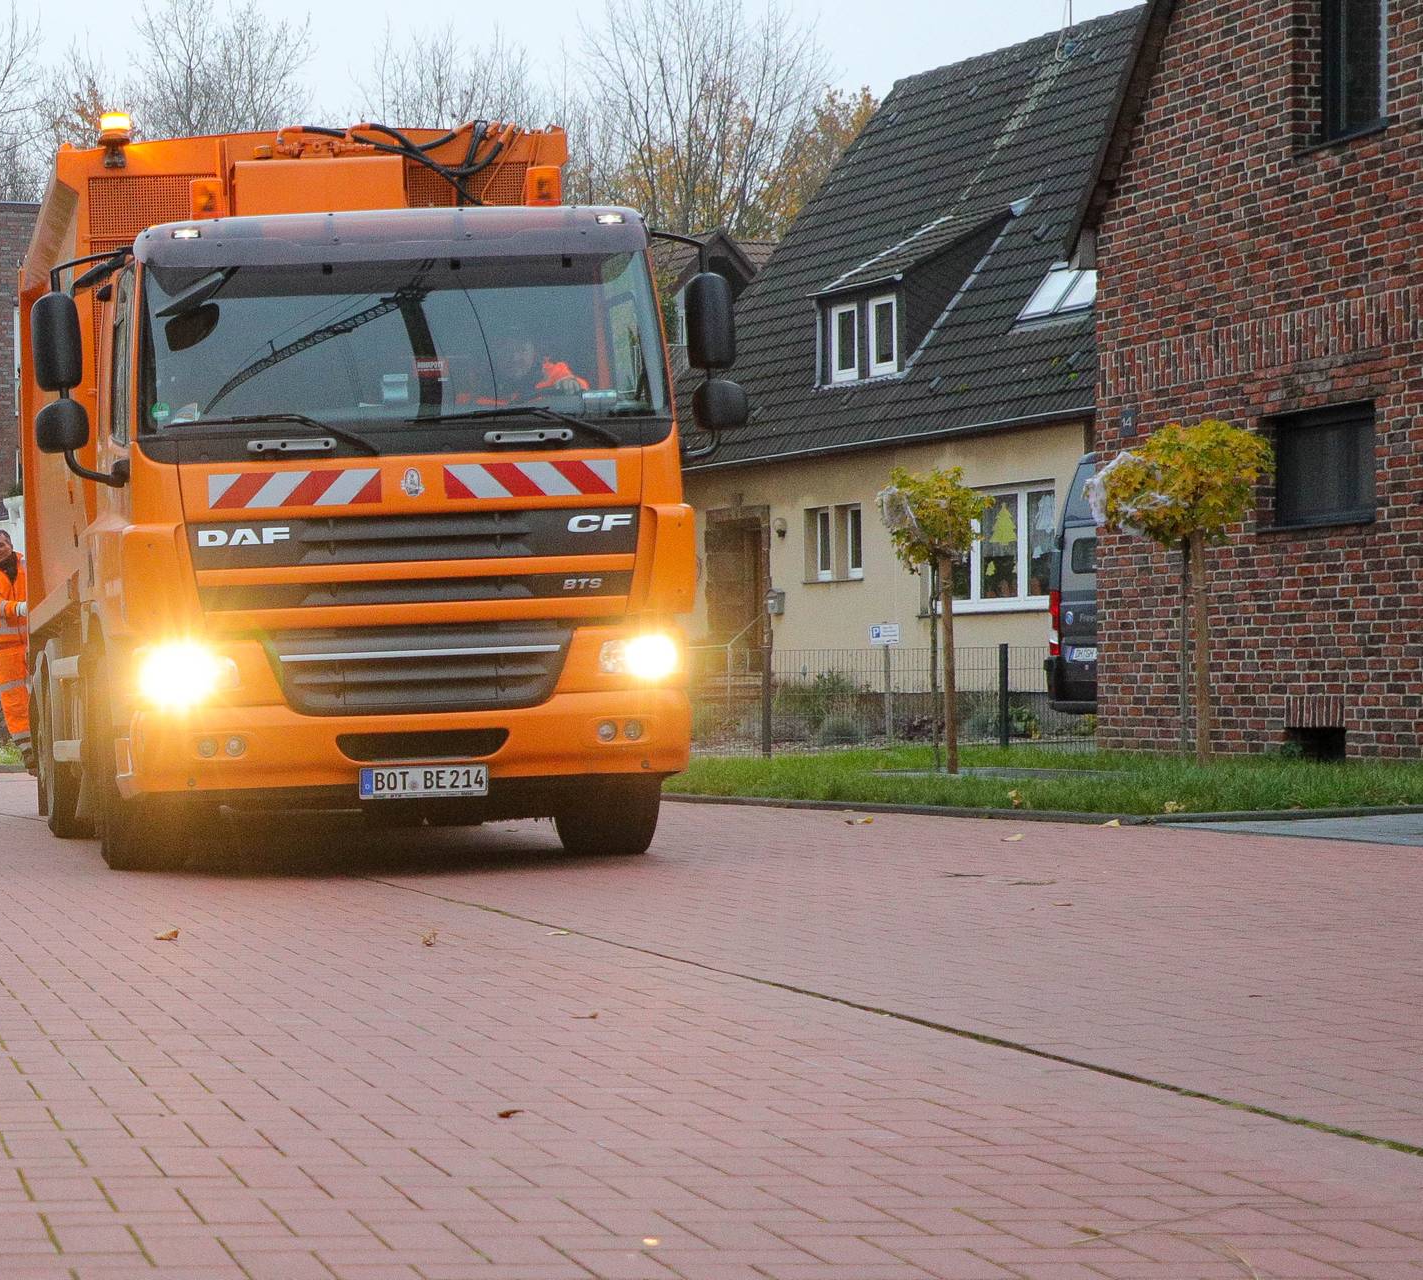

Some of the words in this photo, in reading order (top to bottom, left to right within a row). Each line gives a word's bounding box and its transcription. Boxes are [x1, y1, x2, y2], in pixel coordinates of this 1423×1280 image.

[1122, 416, 1132, 427] 14
[567, 514, 633, 533] CF
[198, 527, 289, 547] DAF
[562, 578, 603, 590] BTS
[374, 771, 409, 791] BOT
[423, 769, 485, 790] BE214
